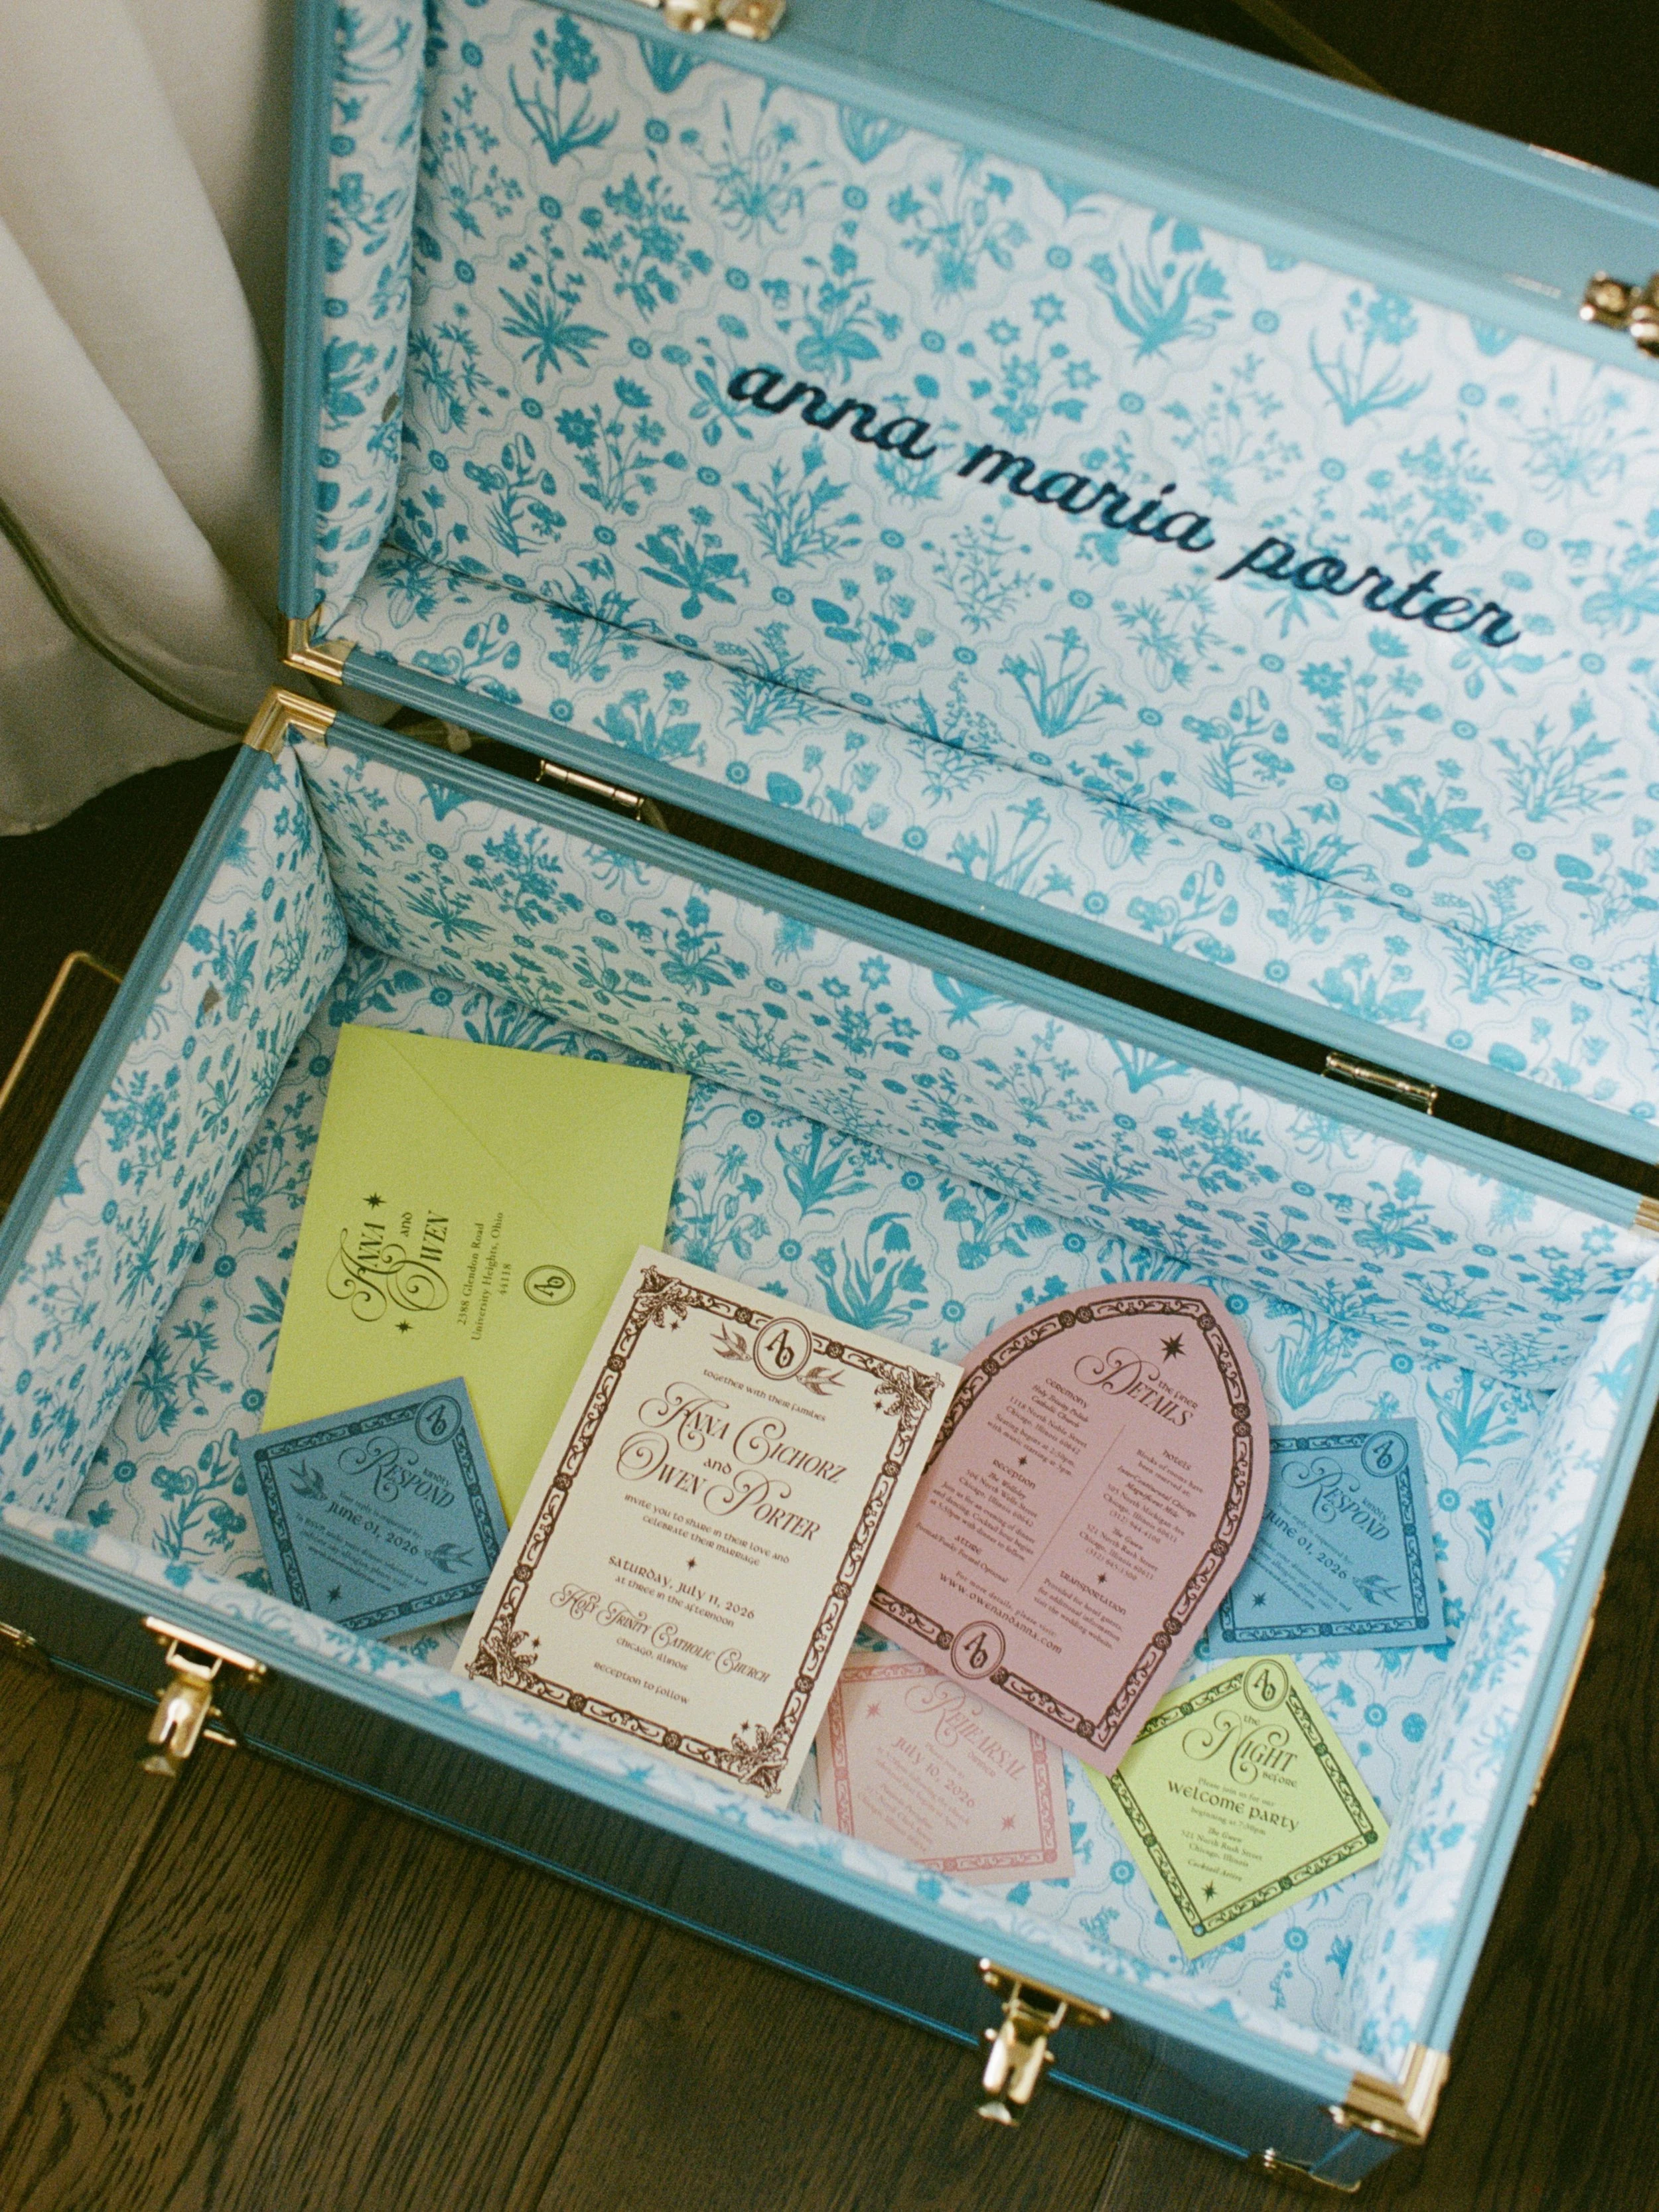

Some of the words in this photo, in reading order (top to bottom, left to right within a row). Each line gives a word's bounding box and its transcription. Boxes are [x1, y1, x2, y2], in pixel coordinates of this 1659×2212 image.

[725, 364, 936, 462] anna
[955, 439, 1217, 553] maria
[1214, 533, 1522, 648] porter
[399, 1211, 413, 1237] and
[470, 1222, 484, 1249] Road
[490, 1211, 504, 1239] Ohio
[462, 1253, 478, 1296] Glendon
[481, 1242, 499, 1285] Heights,
[498, 1263, 512, 1294] 44118
[457, 1300, 470, 1325] 2388
[471, 1288, 492, 1341] University
[703, 1369, 744, 1391] together
[745, 1385, 766, 1399] with
[768, 1394, 790, 1409] their
[791, 1403, 826, 1422] families
[1031, 1384, 1048, 1398] Holy
[1157, 1380, 1174, 1395] the
[1173, 1390, 1198, 1409] finer
[995, 1413, 1019, 1433] Seating
[1019, 1428, 1041, 1446] begins
[1027, 1407, 1047, 1422] North
[1047, 1419, 1068, 1435] Noble
[1068, 1432, 1088, 1448] Street
[1035, 1423, 1058, 1442] Illinois
[1056, 1411, 1080, 1428] Church
[987, 1420, 1002, 1433] with
[1002, 1431, 1022, 1446] music
[1023, 1443, 1048, 1462] starting
[703, 1457, 732, 1476] and
[992, 1458, 1037, 1489] reception
[1136, 1449, 1158, 1466] Blocks
[1167, 1468, 1188, 1484] rooms
[1188, 1480, 1204, 1493] have
[1162, 1449, 1192, 1471] hotels
[1137, 1461, 1153, 1474] been
[1154, 1472, 1182, 1491] reserved
[1120, 1491, 1140, 1508] North
[1141, 1505, 1172, 1528] Michigan
[1173, 1525, 1185, 1536] Ave
[1132, 1511, 1156, 1530] Illinois
[385, 1531, 419, 1555] 2026
[624, 1493, 651, 1510] invite
[653, 1505, 671, 1518] you
[672, 1512, 684, 1523] to
[685, 1518, 712, 1533] share
[713, 1529, 722, 1538] in
[723, 1533, 749, 1548] their
[749, 1542, 770, 1556] love
[772, 1552, 790, 1564] and
[690, 1533, 715, 1549] their
[1112, 1527, 1123, 1539] The
[1100, 1531, 1120, 1548] North
[1120, 1545, 1137, 1558] Rush
[1138, 1556, 1159, 1571] Street
[1316, 1552, 1348, 1580] 2026
[614, 1575, 626, 1585] at
[627, 1580, 655, 1596] three
[656, 1592, 666, 1600] in
[667, 1595, 684, 1608] the
[684, 1603, 735, 1627] afternoon
[725, 1600, 755, 1620] 2026
[955, 1570, 968, 1582] For
[969, 1579, 987, 1594] more
[1015, 1609, 1037, 1625] please
[593, 1661, 642, 1686] reception
[642, 1681, 655, 1691] to
[655, 1685, 689, 1704] follow
[1243, 1714, 1261, 1728] the
[943, 1777, 977, 1809] 2026
[1198, 1777, 1220, 1791] Please
[1222, 1786, 1236, 1795] join
[1248, 1793, 1260, 1802] for
[1262, 1771, 1297, 1788] before
[1167, 1780, 1245, 1815] welcome
[1248, 1806, 1297, 1832] party
[1208, 1827, 1219, 1836] The
[1196, 1834, 1219, 1846] North
[1220, 1842, 1239, 1853] Rush
[1241, 1848, 1263, 1861] Street
